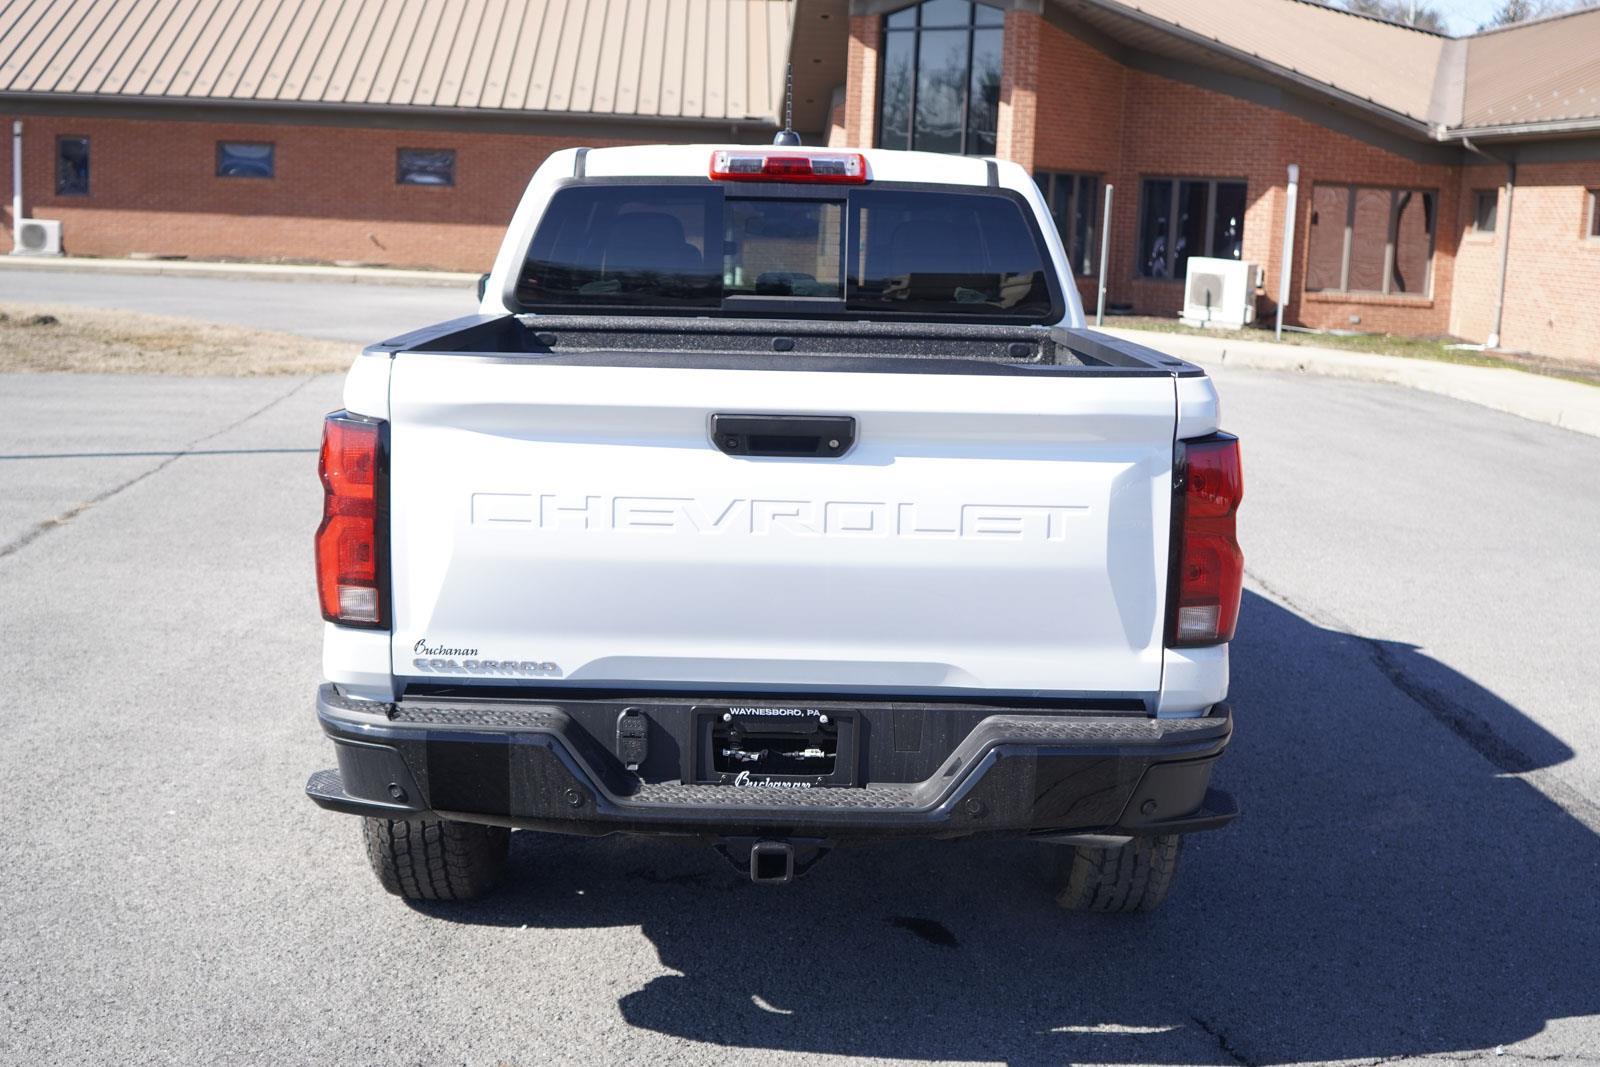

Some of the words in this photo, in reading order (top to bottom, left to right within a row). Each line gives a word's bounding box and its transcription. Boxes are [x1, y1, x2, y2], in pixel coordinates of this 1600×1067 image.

[470, 492, 1092, 543] CHEVROLET
[413, 639, 478, 656] Buchanan
[413, 658, 560, 674] COLORADO
[730, 707, 804, 717] WAYNESBORO,
[807, 709, 820, 717] PA
